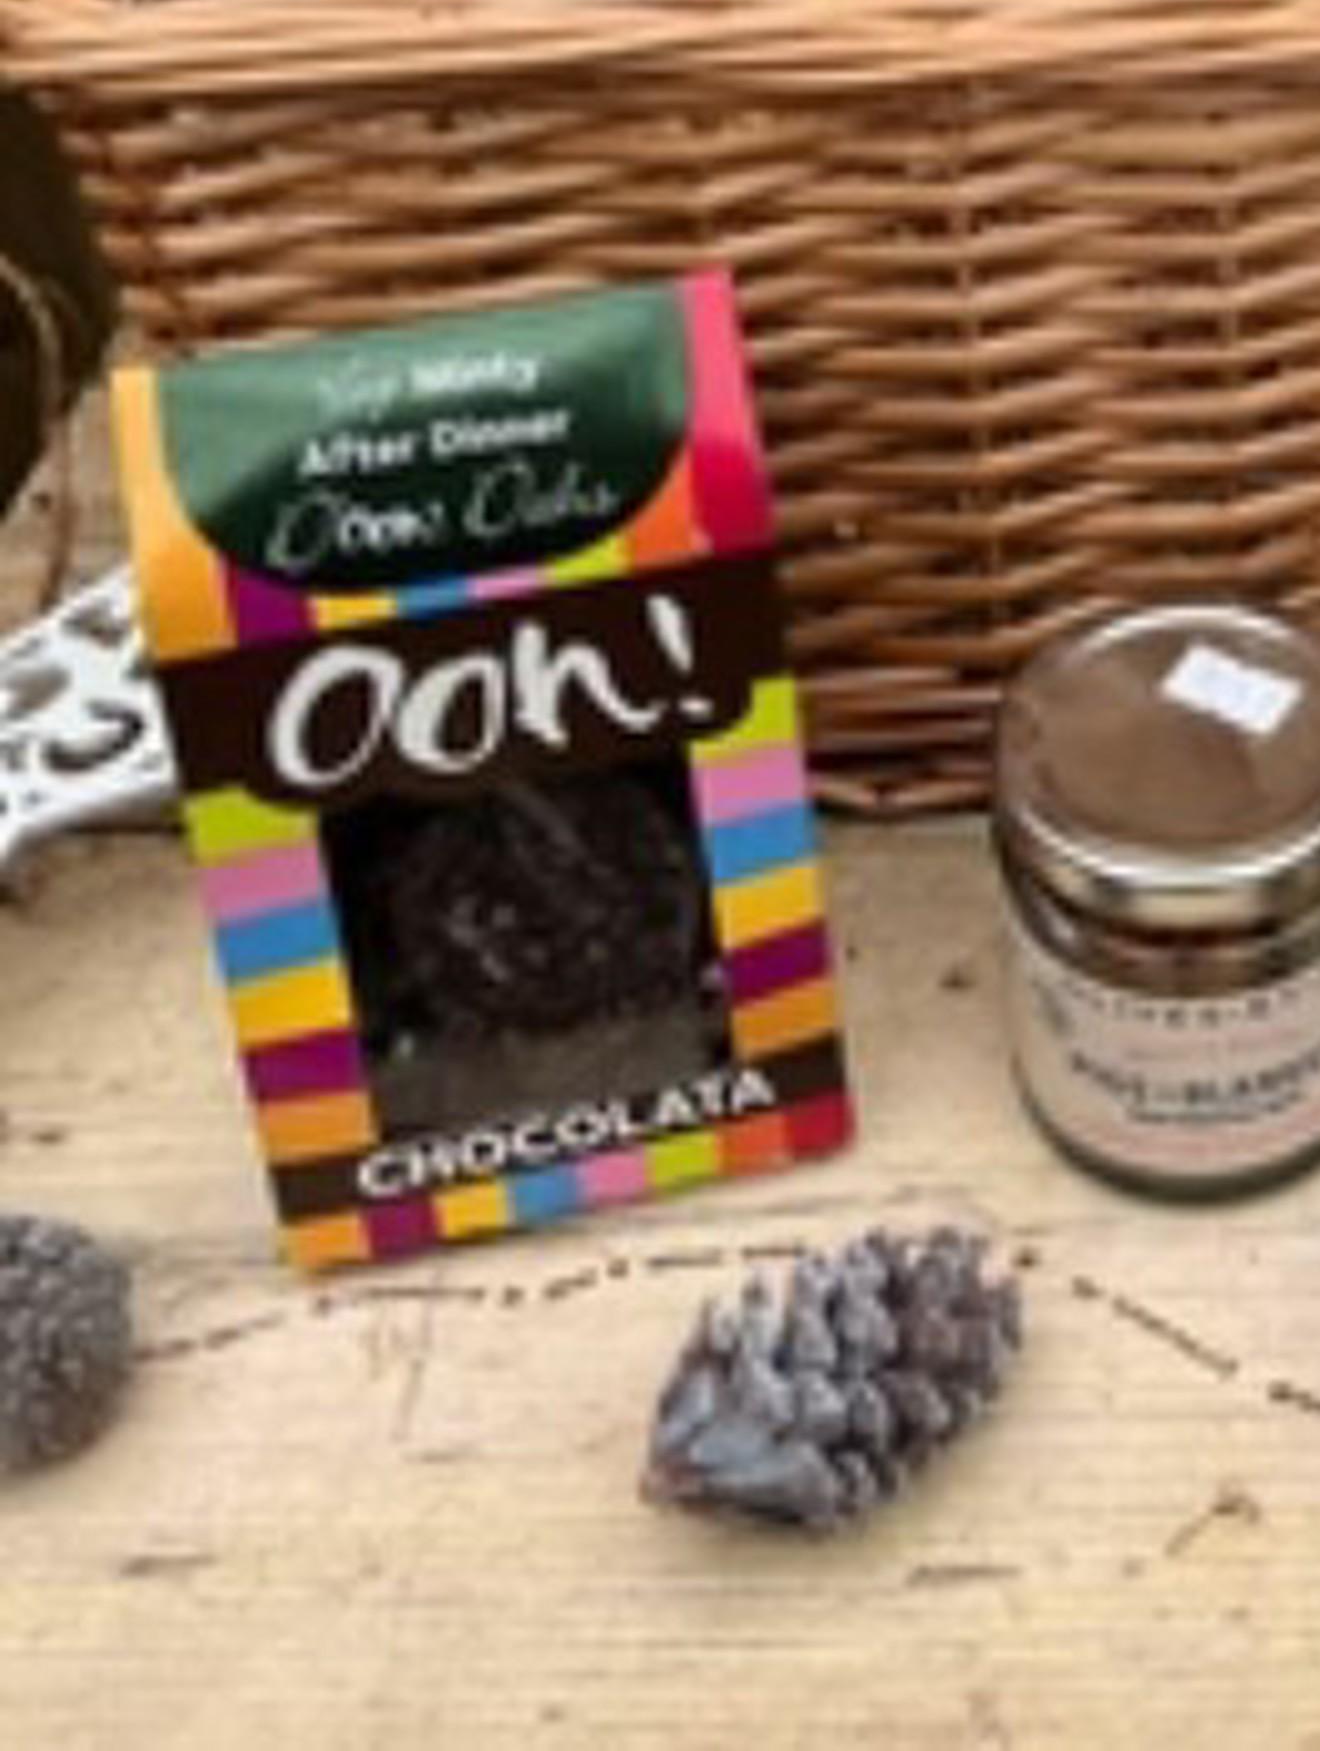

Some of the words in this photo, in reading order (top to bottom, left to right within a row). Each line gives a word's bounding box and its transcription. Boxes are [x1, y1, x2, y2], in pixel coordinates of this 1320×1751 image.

[302, 431, 416, 478] After
[429, 409, 570, 456] Dinner
[267, 593, 714, 790] Ooh!
[356, 1067, 777, 1198] CHOCOLATA
